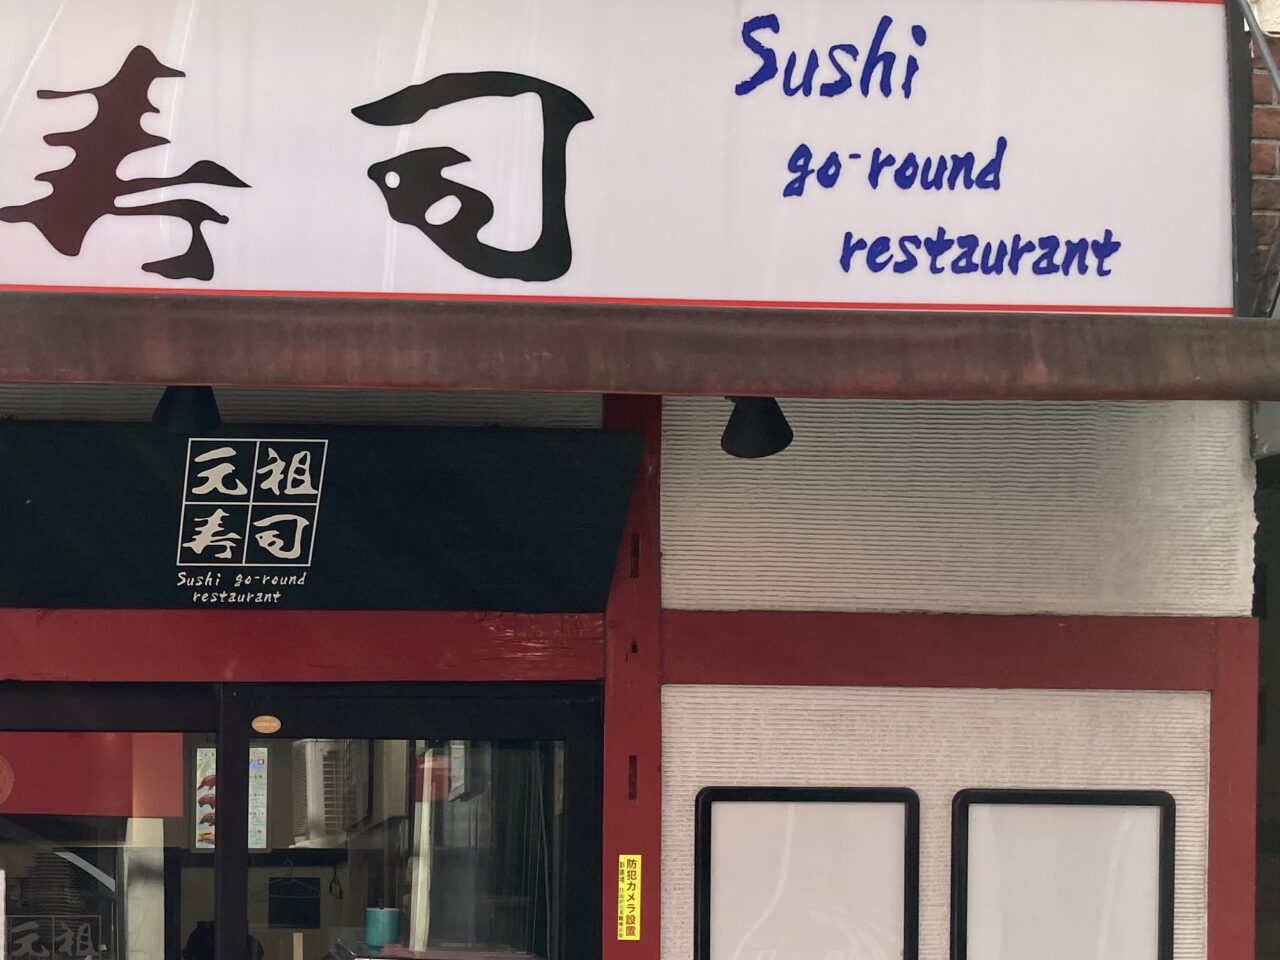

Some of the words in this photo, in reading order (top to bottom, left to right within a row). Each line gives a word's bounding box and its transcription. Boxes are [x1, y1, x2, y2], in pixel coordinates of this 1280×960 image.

[735, 14, 926, 98] Sushi
[783, 136, 1007, 197] go-round
[839, 226, 1121, 276] restaurant
[192, 447, 319, 496] 元祖
[182, 508, 310, 559] 寿司
[177, 571, 221, 586] Sushi
[234, 571, 307, 587] go-round
[193, 591, 282, 603] restaurant
[625, 858, 638, 937] 防犯カメラ設置
